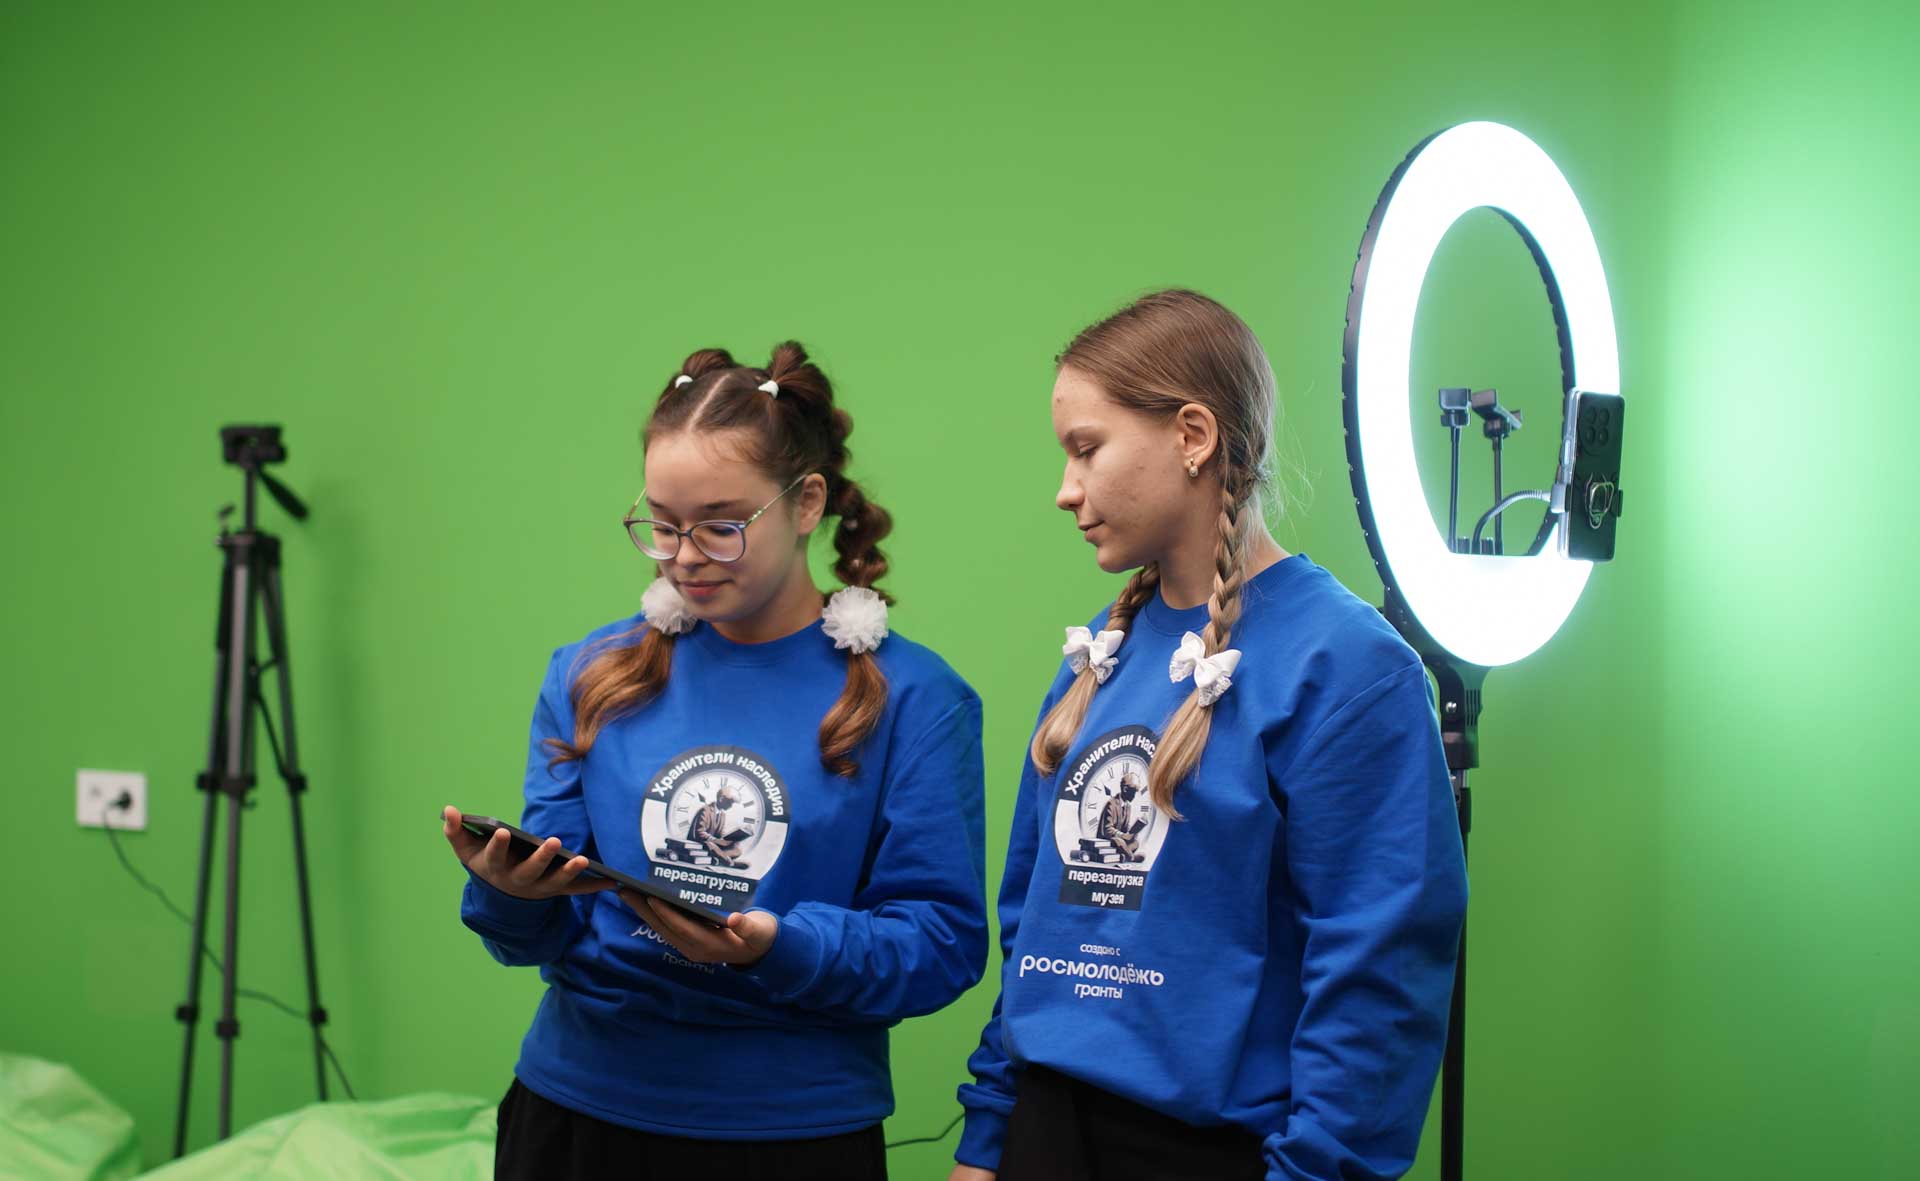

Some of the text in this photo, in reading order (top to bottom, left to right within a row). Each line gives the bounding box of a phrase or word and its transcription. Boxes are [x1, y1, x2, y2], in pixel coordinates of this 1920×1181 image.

[1064, 734, 1134, 795] Хранители
[652, 752, 784, 816] Хранители наследия
[655, 866, 749, 892] перезагрузка
[1068, 869, 1143, 887] перезагрузка
[679, 888, 722, 905] музея
[1091, 891, 1124, 905] музея
[1080, 943, 1115, 955] создано
[1019, 955, 1165, 986] росмолодёжь
[1074, 983, 1123, 999] гранты
